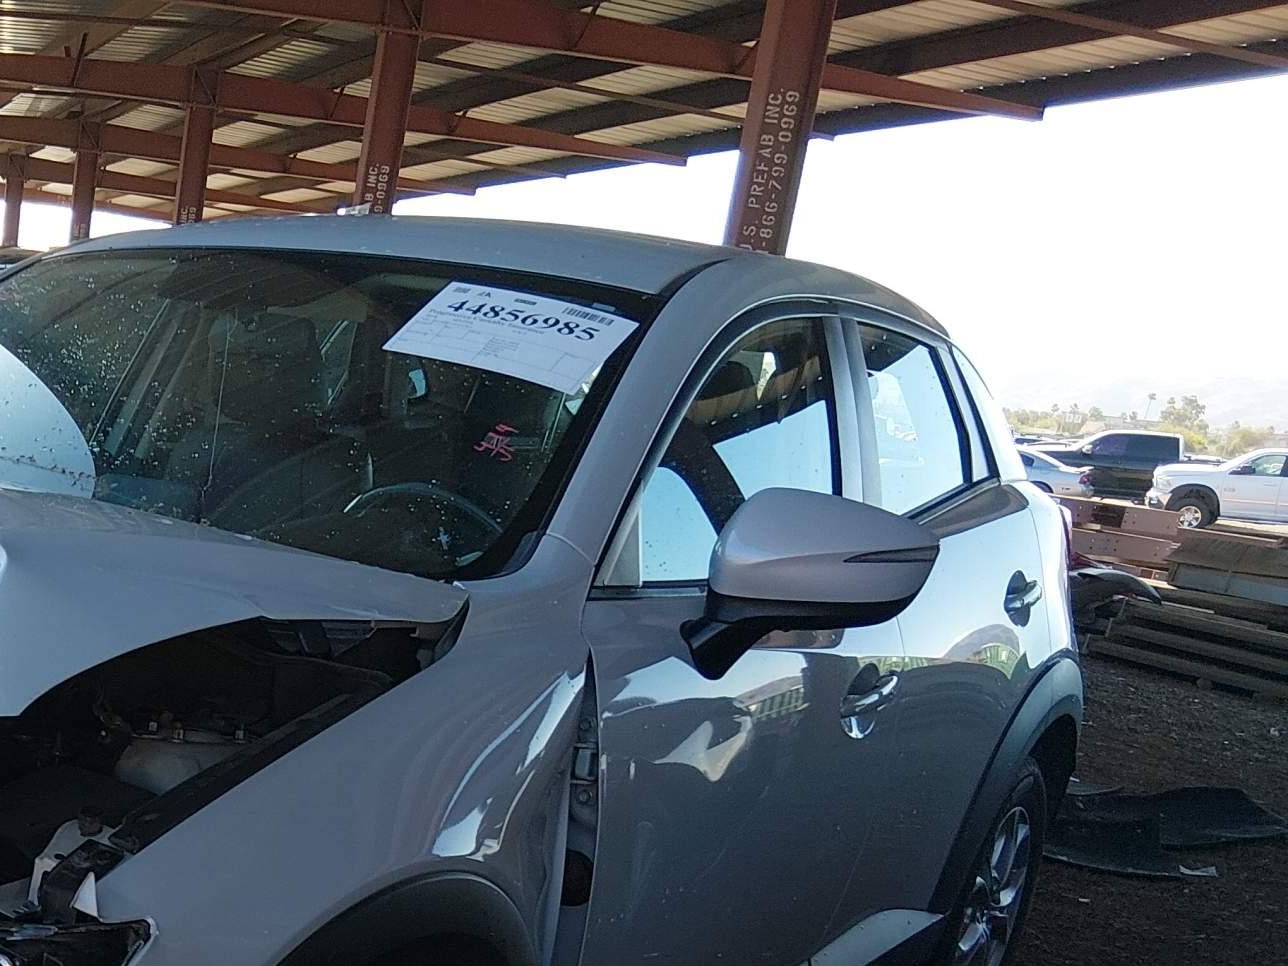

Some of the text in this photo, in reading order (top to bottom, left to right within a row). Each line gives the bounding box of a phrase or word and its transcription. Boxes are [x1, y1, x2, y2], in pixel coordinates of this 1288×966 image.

[748, 134, 775, 208] PREFAB
[765, 88, 784, 124] INC.
[366, 163, 379, 188] INC.
[447, 300, 600, 341] 44856985
